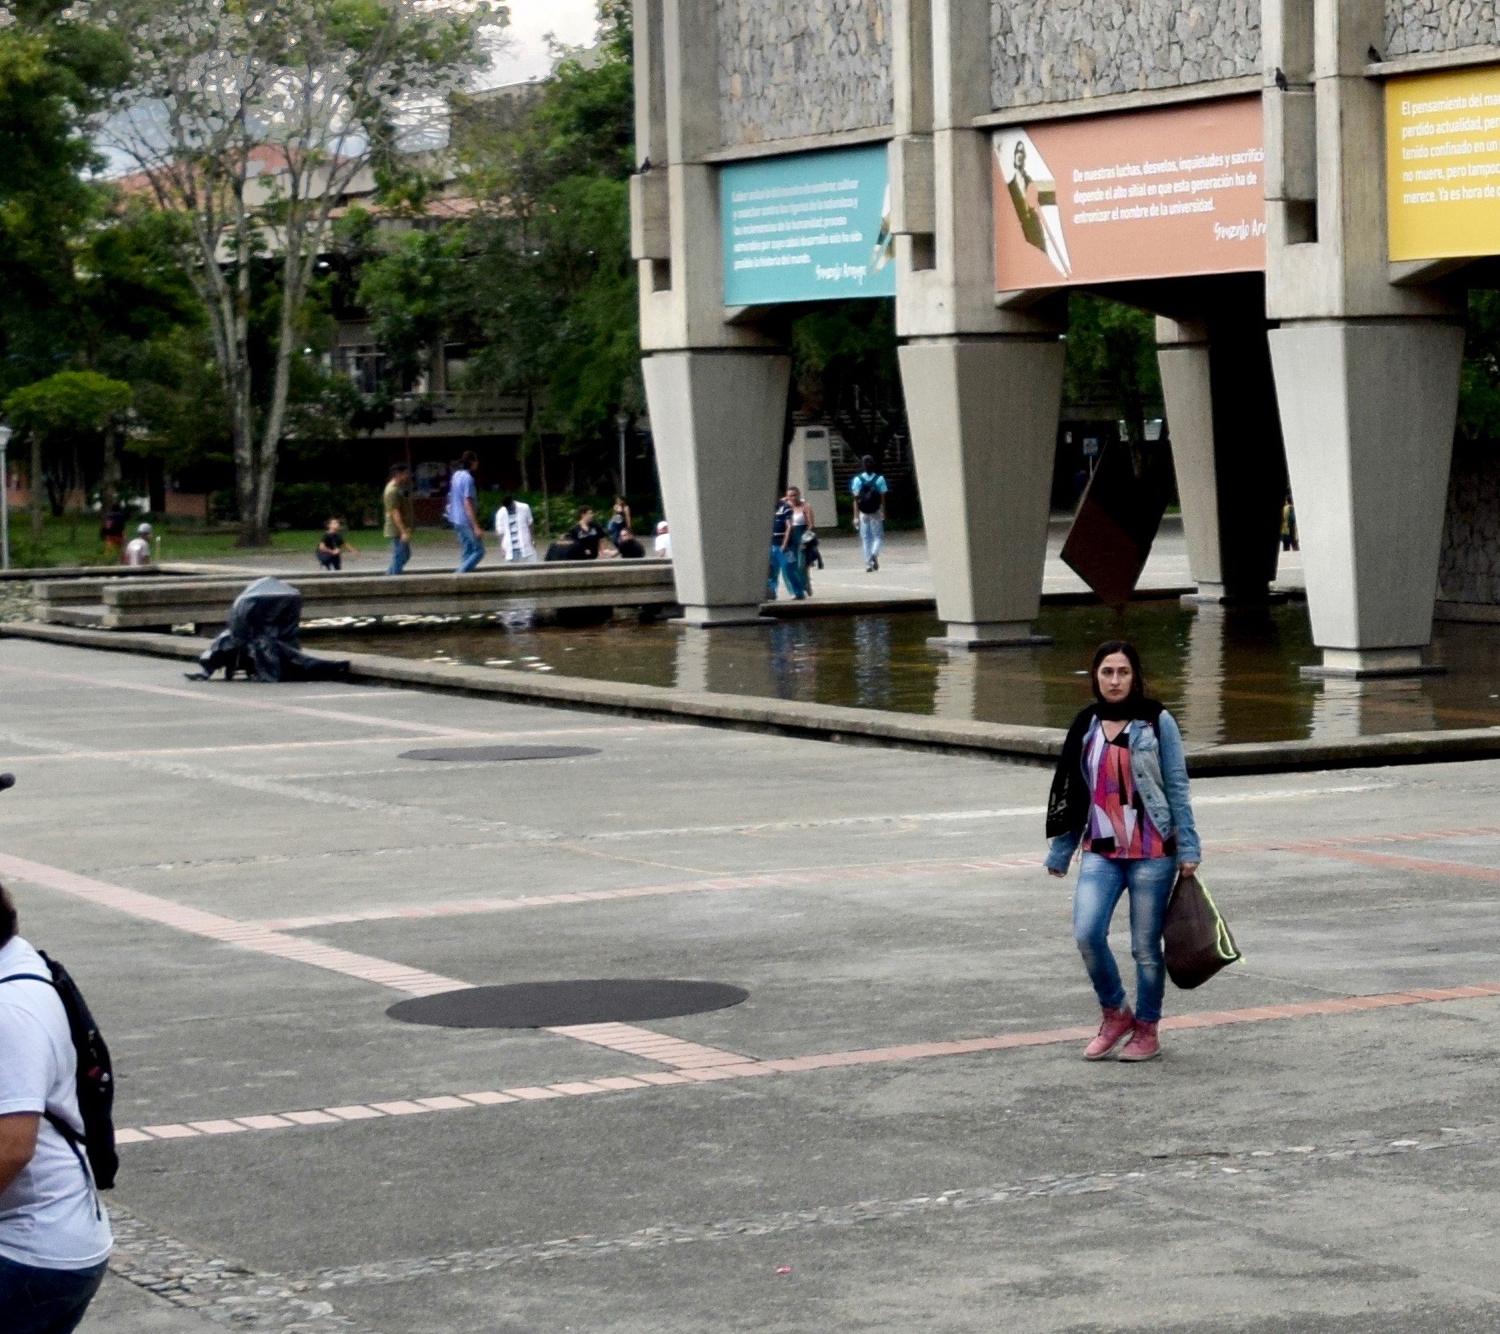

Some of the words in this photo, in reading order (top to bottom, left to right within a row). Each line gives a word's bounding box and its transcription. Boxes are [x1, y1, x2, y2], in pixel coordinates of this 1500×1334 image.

[1474, 142, 1484, 152] en
[1487, 141, 1497, 151] un
[1403, 171, 1414, 181] no
[1450, 190, 1460, 200] es
[1484, 185, 1495, 197] de
